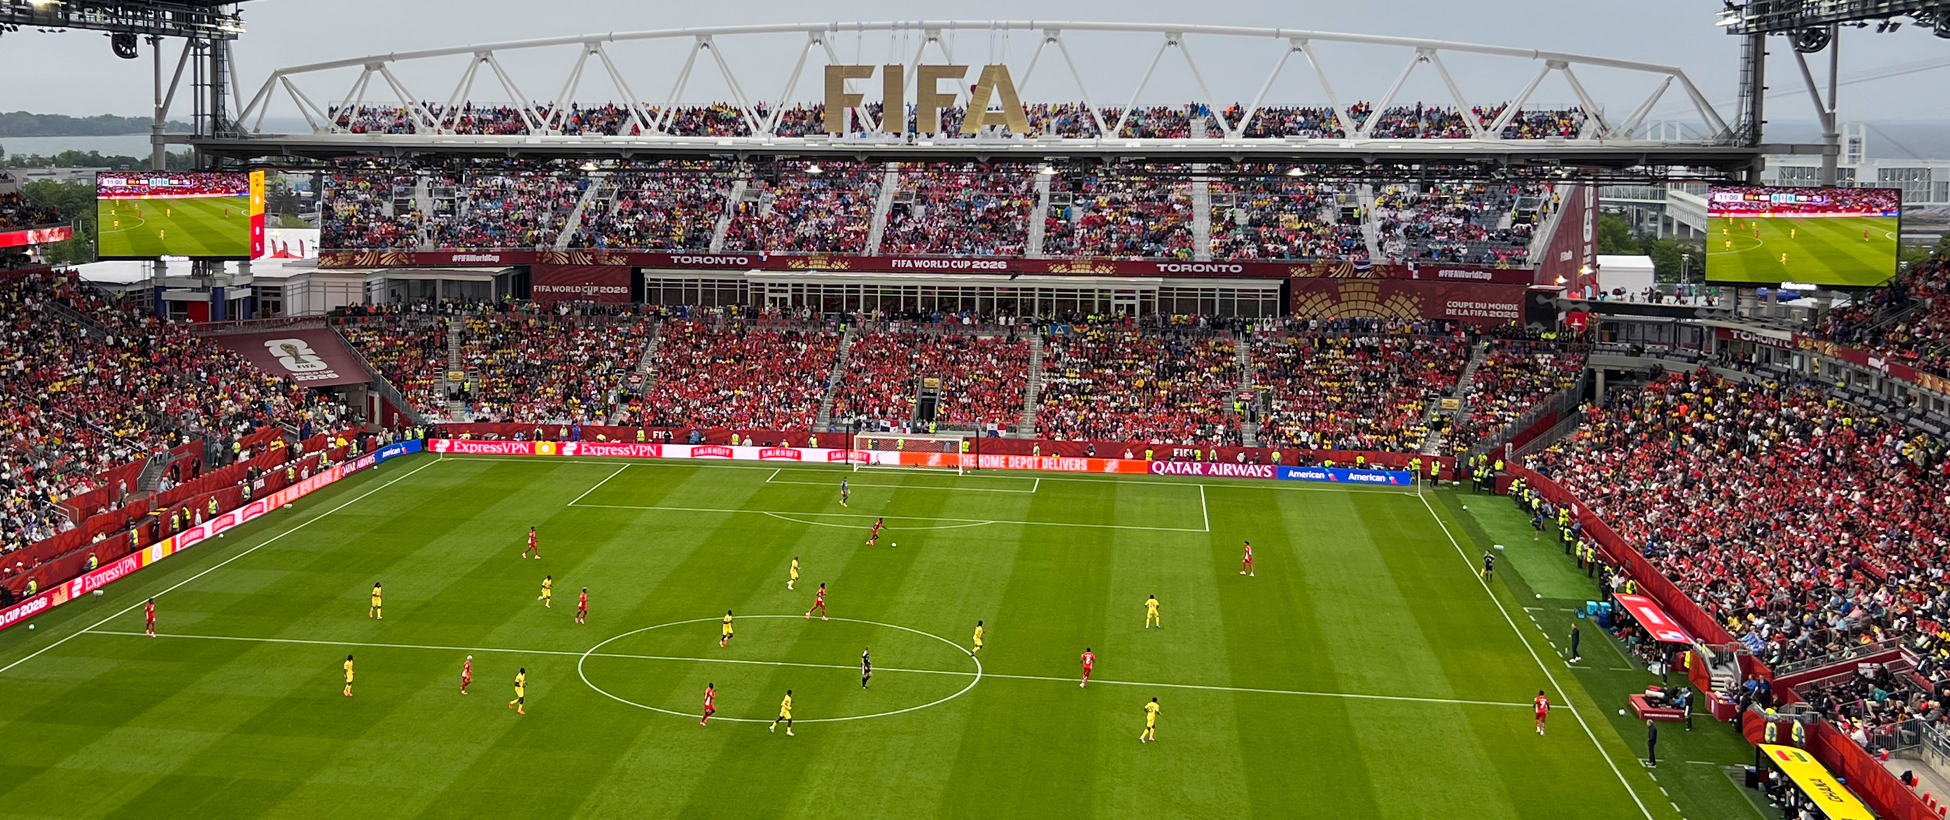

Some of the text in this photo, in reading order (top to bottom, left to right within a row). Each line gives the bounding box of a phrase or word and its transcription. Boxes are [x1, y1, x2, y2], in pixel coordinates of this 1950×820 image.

[824, 64, 1030, 133] FIFA
[670, 255, 749, 266] TORONTO
[892, 259, 1008, 270] FIFA WORLD CUP 2026
[1156, 263, 1243, 273] TORONTO
[1438, 269, 1492, 280] #FIFAWorldCup
[533, 285, 551, 293] FIFA
[552, 285, 580, 293] WORLD
[454, 441, 530, 454] ExpressVPN
[581, 444, 657, 457] ExpressVPN
[692, 448, 730, 457] SMIRNOFF
[761, 449, 800, 459] SMIRNOFF
[978, 455, 1005, 468] HOME
[1008, 456, 1038, 470] DEPOT
[1042, 458, 1088, 472] DELIVERS
[1152, 460, 1272, 478] QATAR AIRWAYS
[1288, 470, 1326, 480] American
[1348, 472, 1386, 482] American
[254, 479, 265, 490] FIFA
[85, 556, 137, 591] ExpressVPN
[4, 608, 21, 623] CUP
[20, 597, 44, 616] 2026
